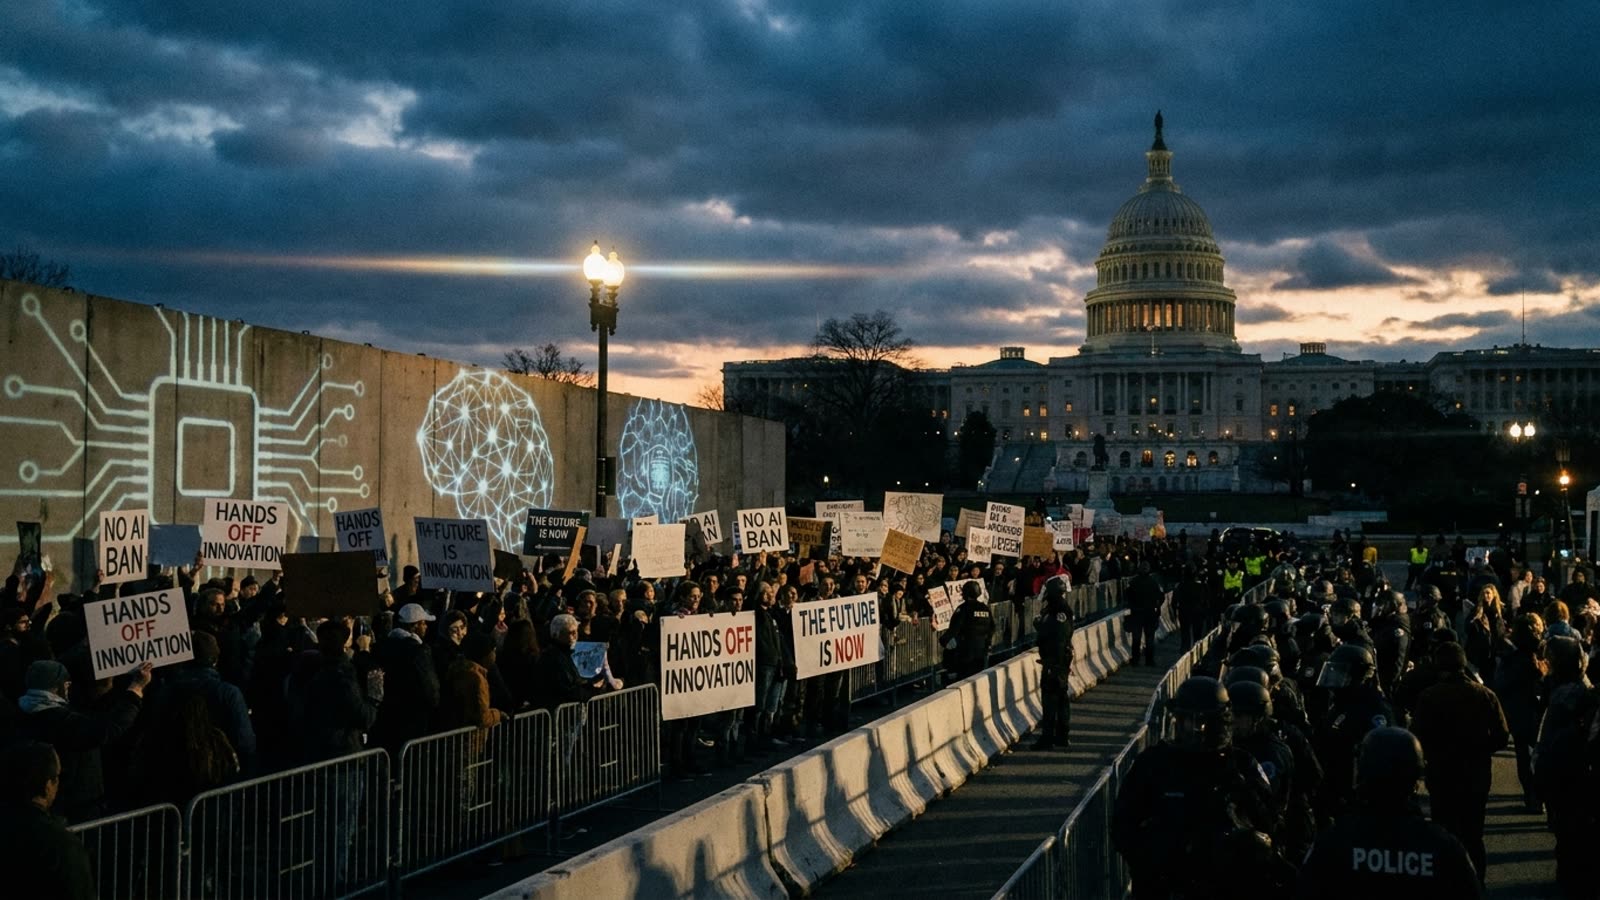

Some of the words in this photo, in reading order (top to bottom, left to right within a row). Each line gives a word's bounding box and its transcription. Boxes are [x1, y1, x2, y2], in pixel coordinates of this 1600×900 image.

[216, 502, 277, 524] HANDS
[335, 510, 381, 532] HANDS
[529, 516, 547, 526] THE
[703, 513, 716, 527] AI
[743, 512, 765, 528] NO
[768, 511, 782, 527] AI
[104, 516, 127, 542] NO
[130, 515, 145, 540] AI
[228, 524, 264, 543] OFF
[347, 530, 373, 548] OFF
[434, 522, 485, 542] FUTURE
[539, 528, 548, 538] IS
[548, 529, 569, 539] NOW
[746, 529, 782, 549] BAN
[106, 544, 143, 577] BAN
[203, 542, 285, 563] INNOVATION
[442, 544, 458, 560] IS
[423, 562, 490, 580] INNOVATION
[102, 593, 171, 626] HANDS
[799, 607, 827, 637] THE
[829, 600, 877, 633] FUTURE
[121, 620, 156, 642] OFF
[95, 632, 191, 671] INNOVATION
[666, 628, 722, 662] HANDS
[725, 625, 753, 655] OFF
[819, 639, 833, 667] IS
[834, 633, 865, 664] NOW
[665, 659, 754, 695] INNOVATION
[1352, 847, 1434, 877] POLICE
